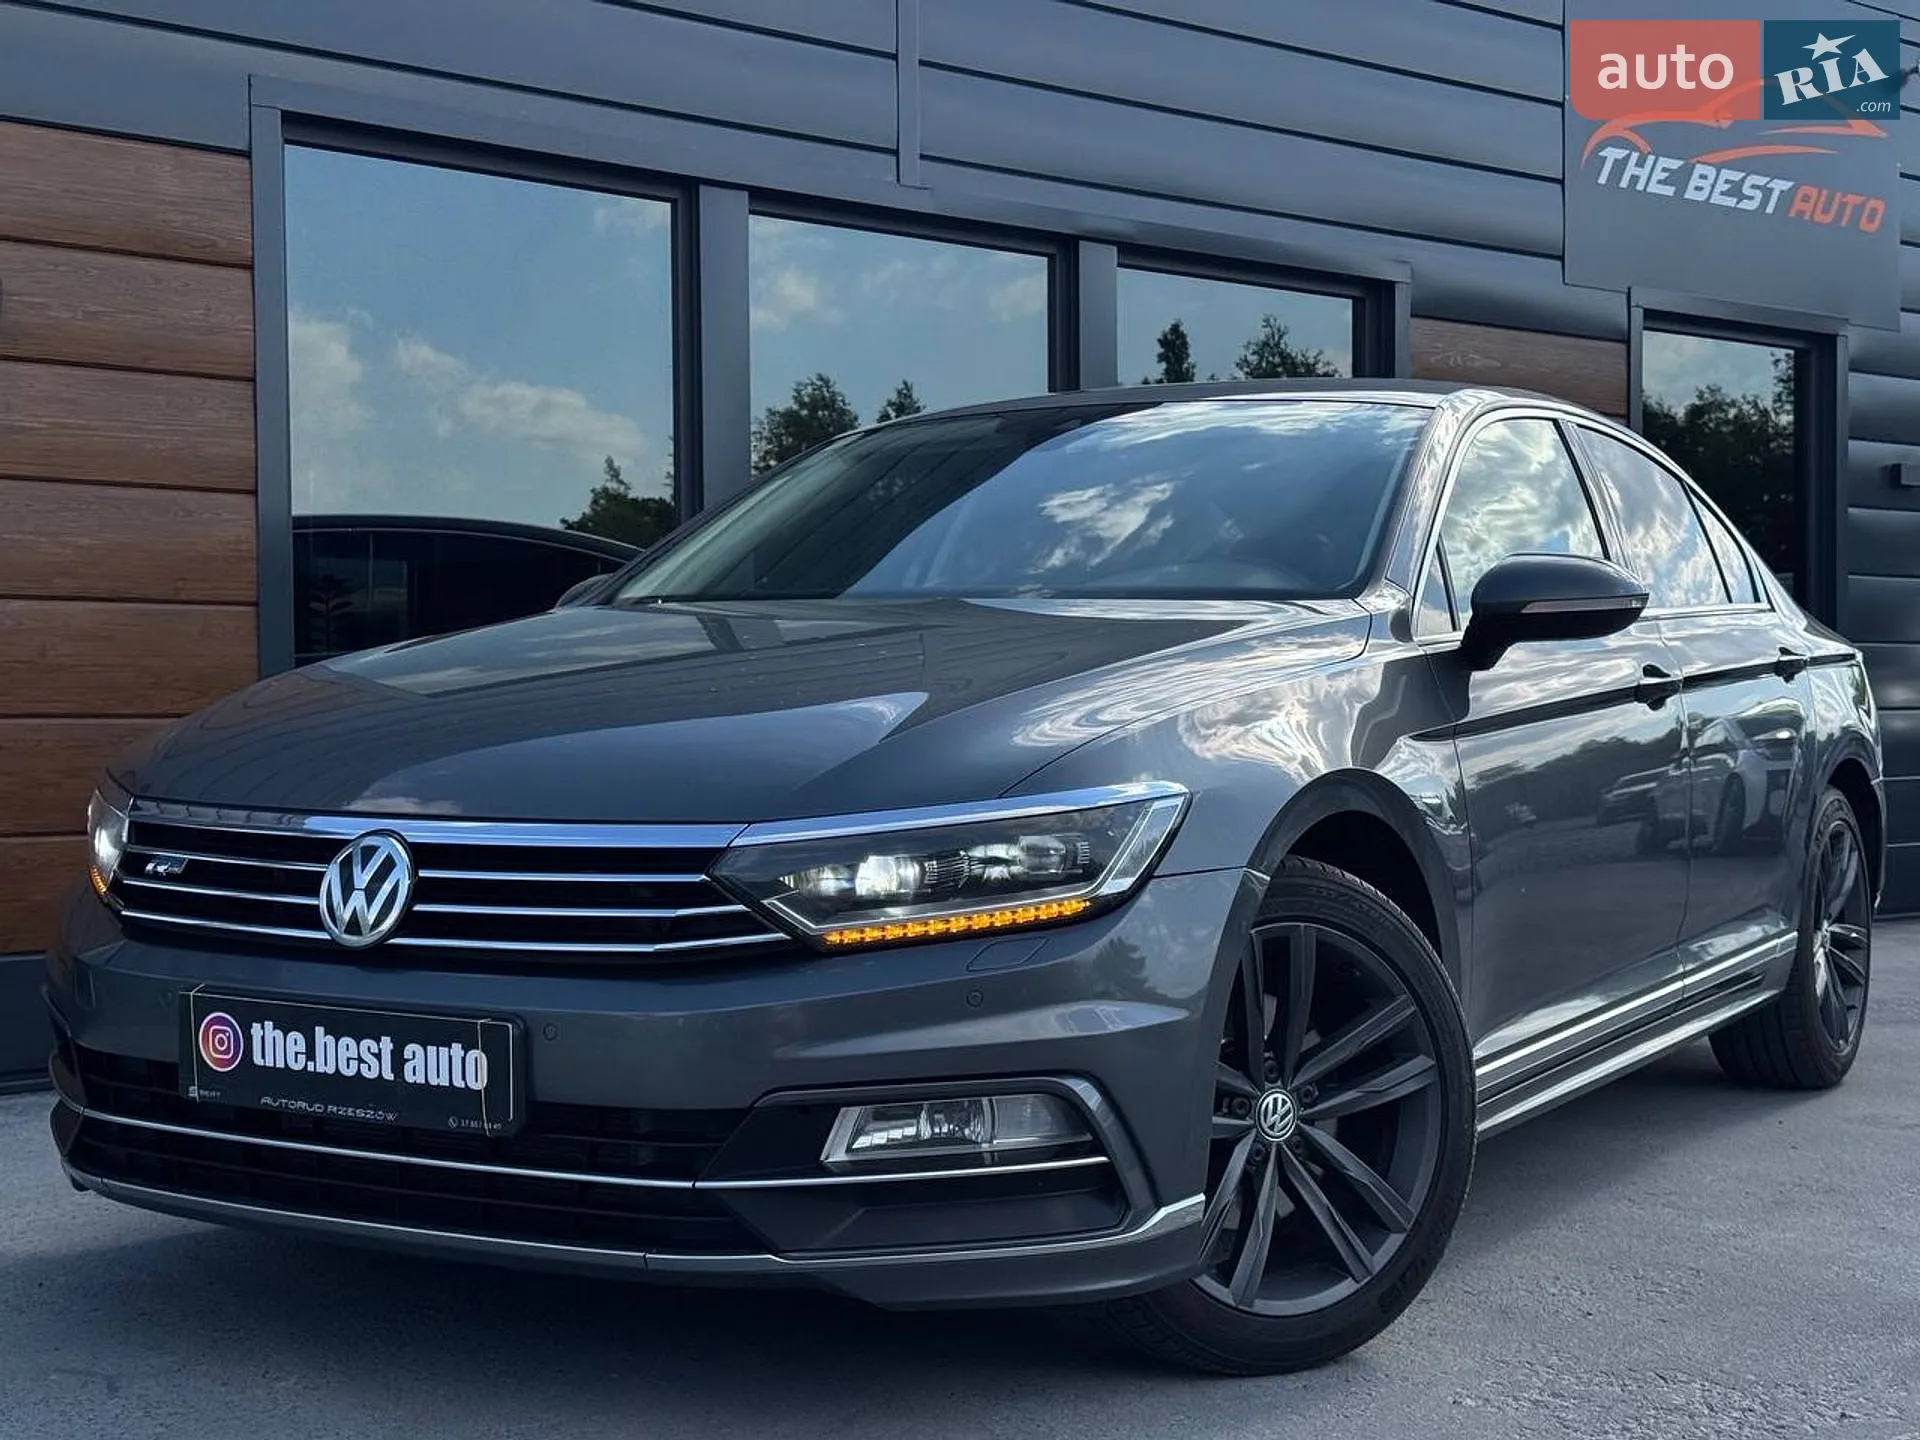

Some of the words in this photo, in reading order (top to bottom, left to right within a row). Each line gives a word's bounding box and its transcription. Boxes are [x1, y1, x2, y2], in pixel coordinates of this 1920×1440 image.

[1597, 147, 1685, 197] THE
[1684, 163, 1795, 214] BEST
[1788, 186, 1887, 233] AUTO
[251, 1021, 394, 1080] the.best
[403, 1042, 488, 1090] auto
